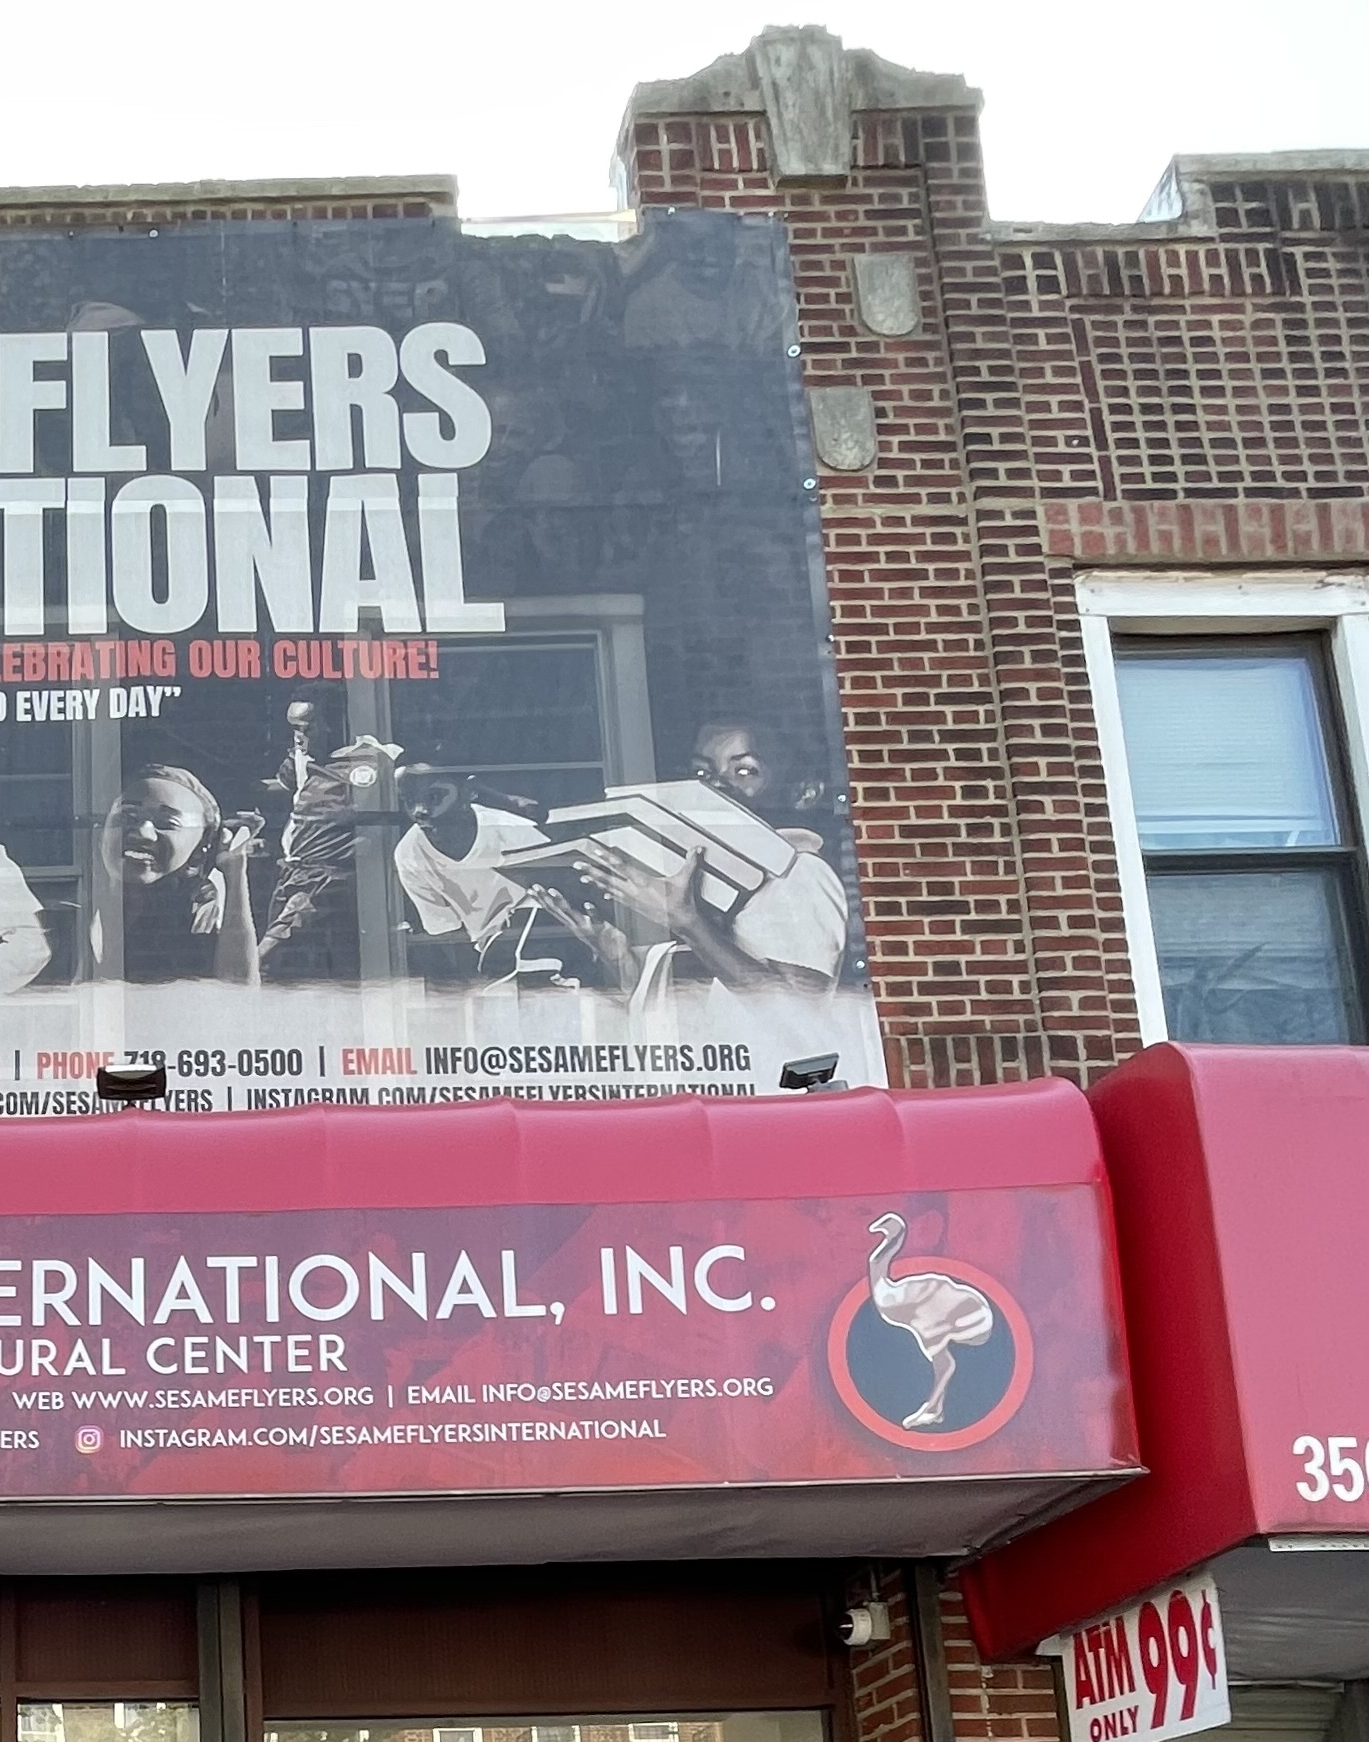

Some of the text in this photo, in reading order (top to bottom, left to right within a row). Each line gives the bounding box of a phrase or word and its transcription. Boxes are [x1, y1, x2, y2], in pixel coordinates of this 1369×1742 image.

[188, 639, 261, 679] OUR
[272, 638, 440, 679] CULTURE!
[16, 688, 100, 722] EVERY
[109, 685, 182, 719] DAY”
[342, 1047, 417, 1076] EMAIL
[425, 1044, 752, 1076] INFO@SESAMEFLYERS.ORG
[600, 1244, 776, 1315] INC.
[146, 1334, 348, 1375] CENTER
[11, 1391, 65, 1410] WEB
[70, 1387, 374, 1409] WWW.SESAMEFLYERS.ORG
[407, 1384, 476, 1405] EMAIL
[481, 1377, 774, 1403] INFO@SESAMEFLYERS.ORG
[119, 1419, 667, 1449] INSTAGRAM.COM/SESAMEFLYERSINTERNATIONAL
[1292, 1435, 1369, 1502] 35
[1072, 1614, 1136, 1710] ATM
